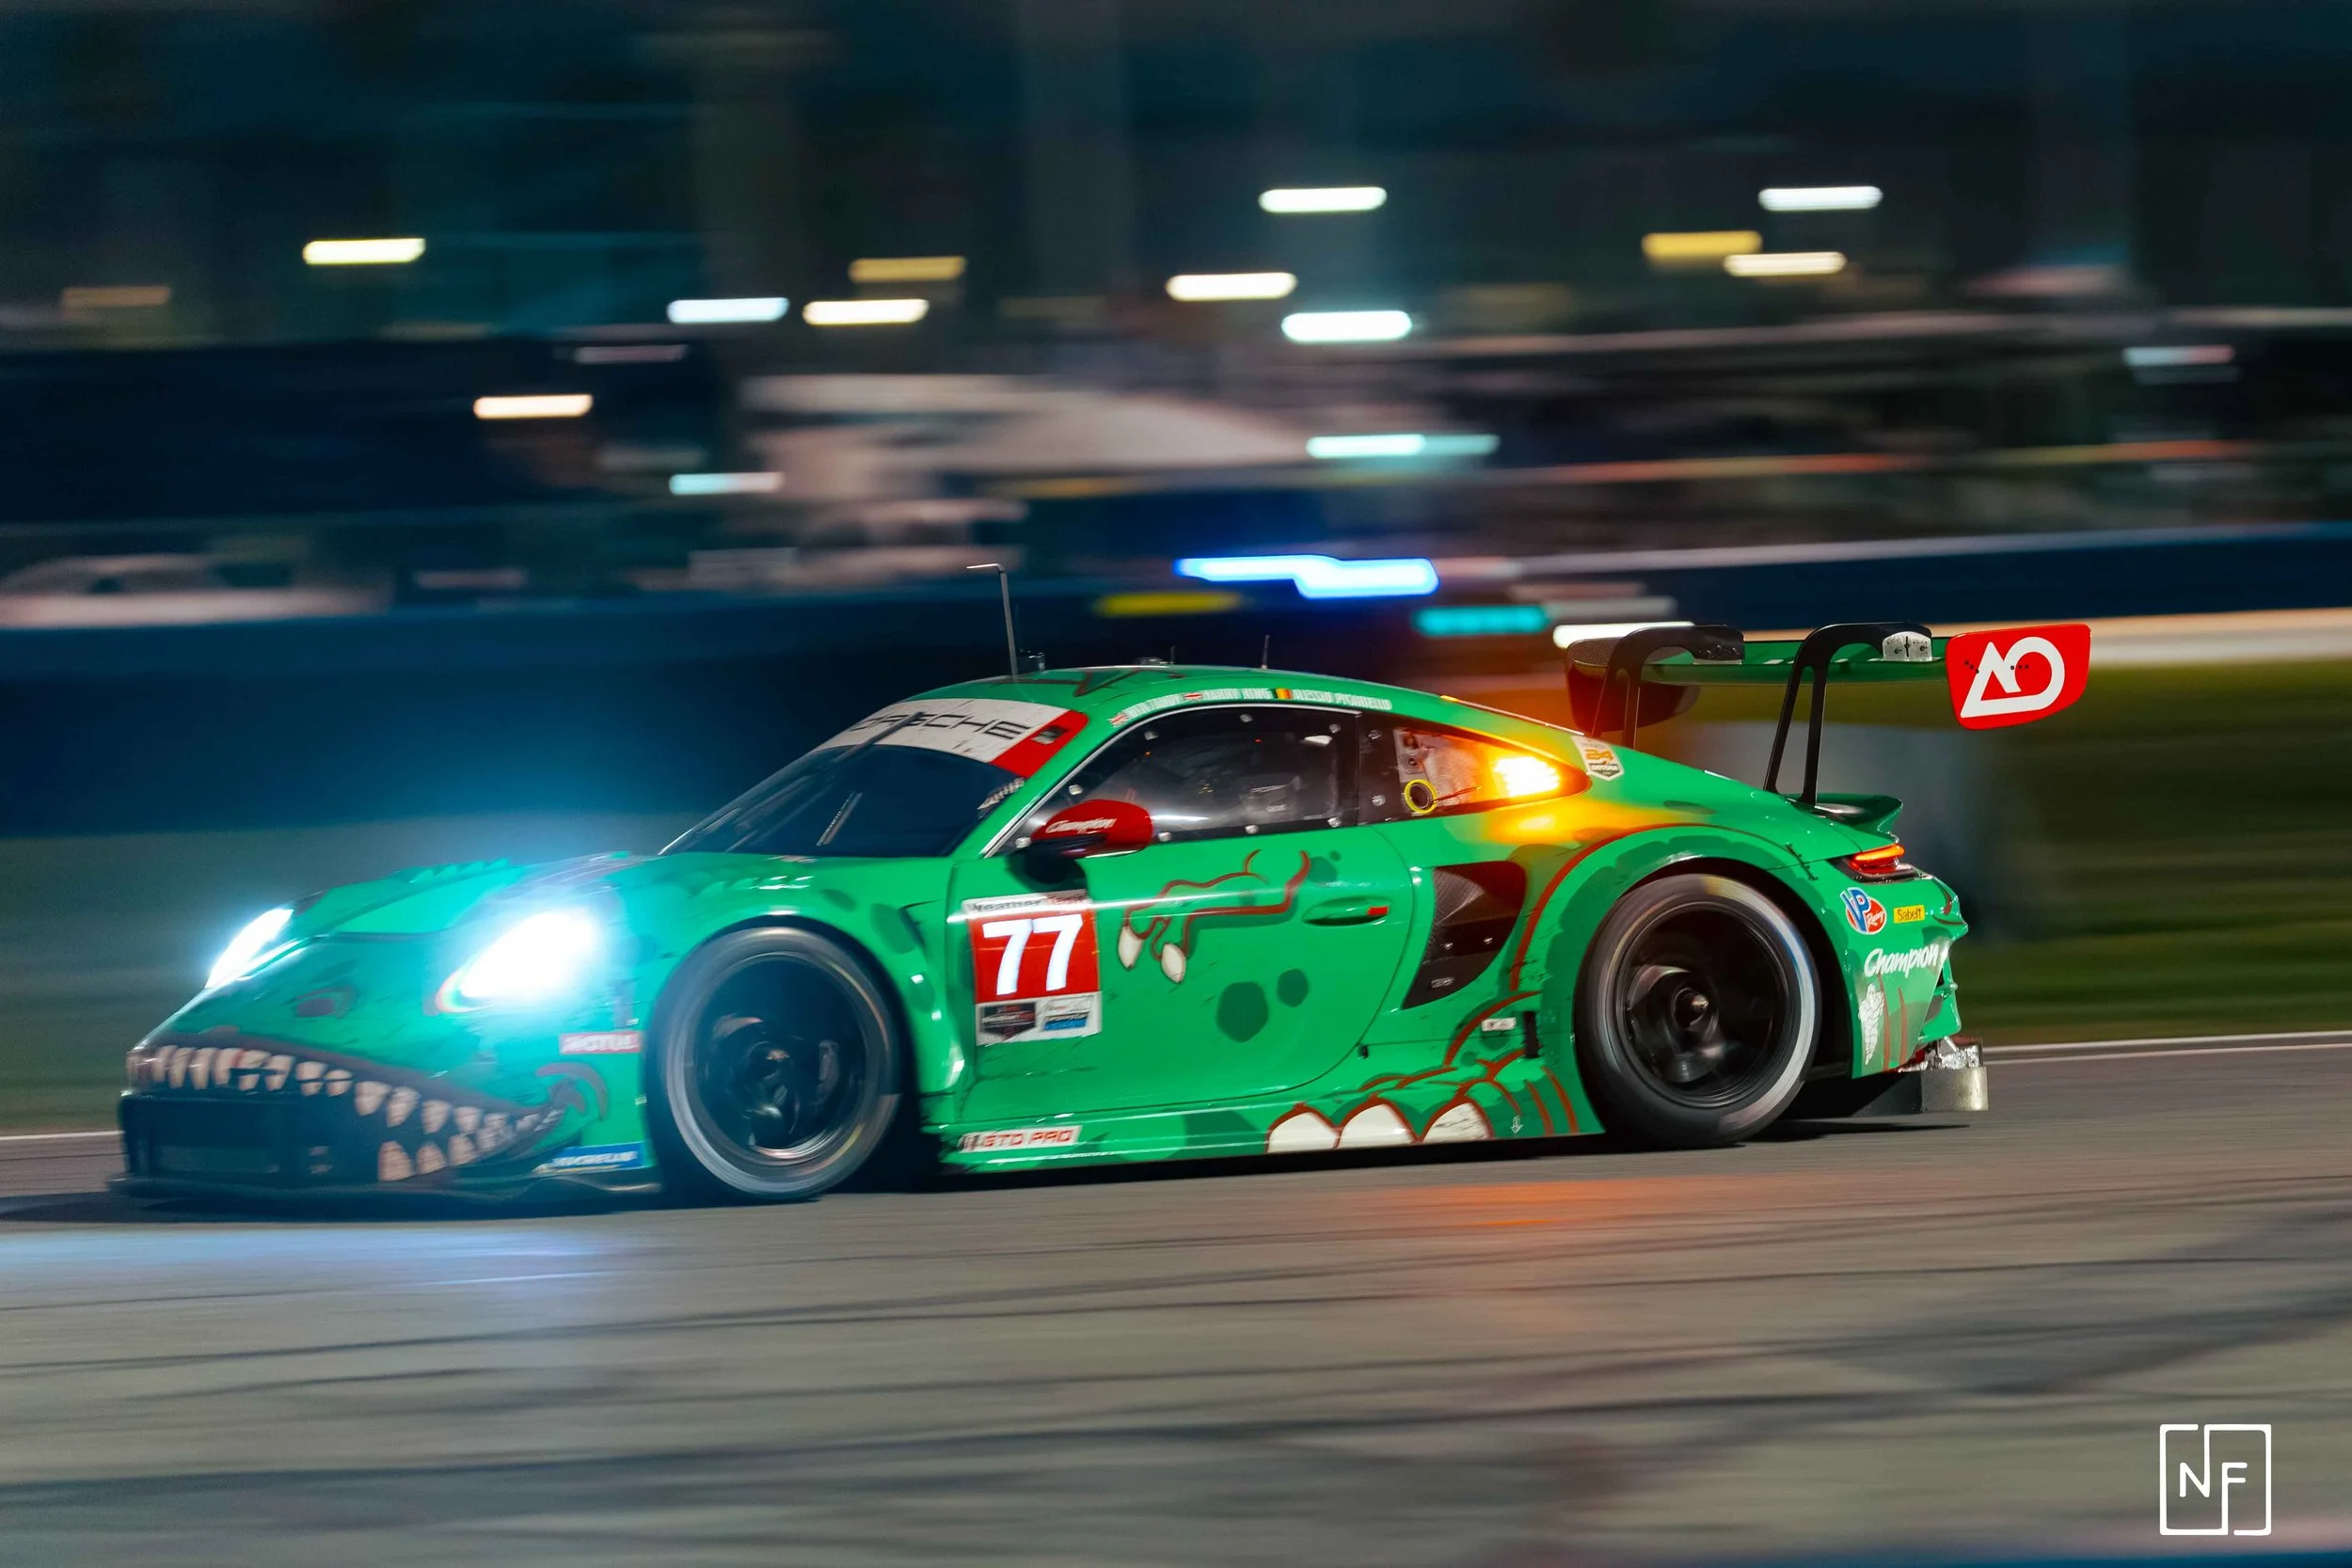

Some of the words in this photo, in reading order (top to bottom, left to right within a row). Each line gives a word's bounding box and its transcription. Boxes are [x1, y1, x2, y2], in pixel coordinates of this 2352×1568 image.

[1897, 908, 1922, 922] Sabelt
[982, 913, 1083, 996] 77
[1864, 943, 1940, 978] Champion
[1028, 1130, 1073, 1145] PRO
